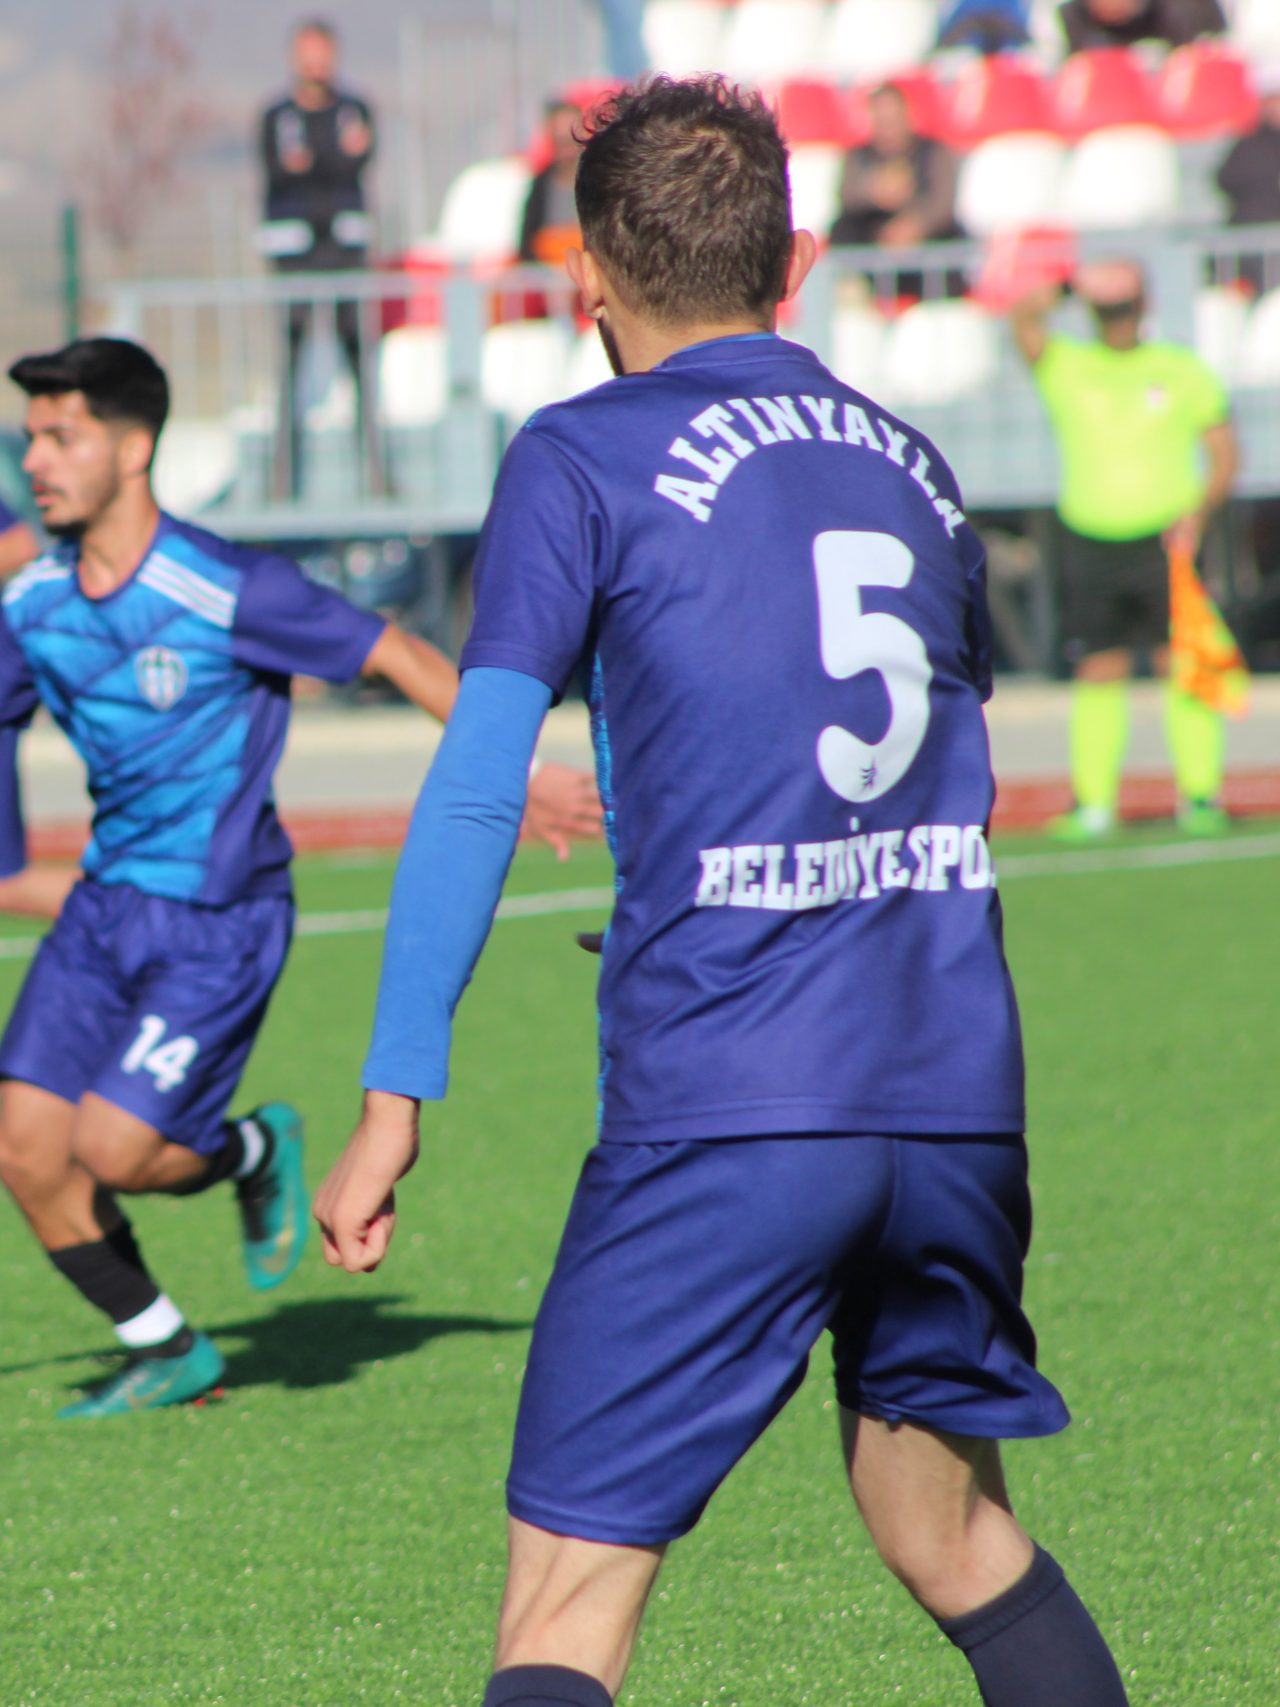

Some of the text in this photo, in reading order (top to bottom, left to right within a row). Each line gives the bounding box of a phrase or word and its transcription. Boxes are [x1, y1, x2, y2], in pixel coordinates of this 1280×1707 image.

[813, 530, 933, 802] 5
[695, 816, 997, 910] BELEDİYESPO
[121, 1013, 199, 1093] 14
